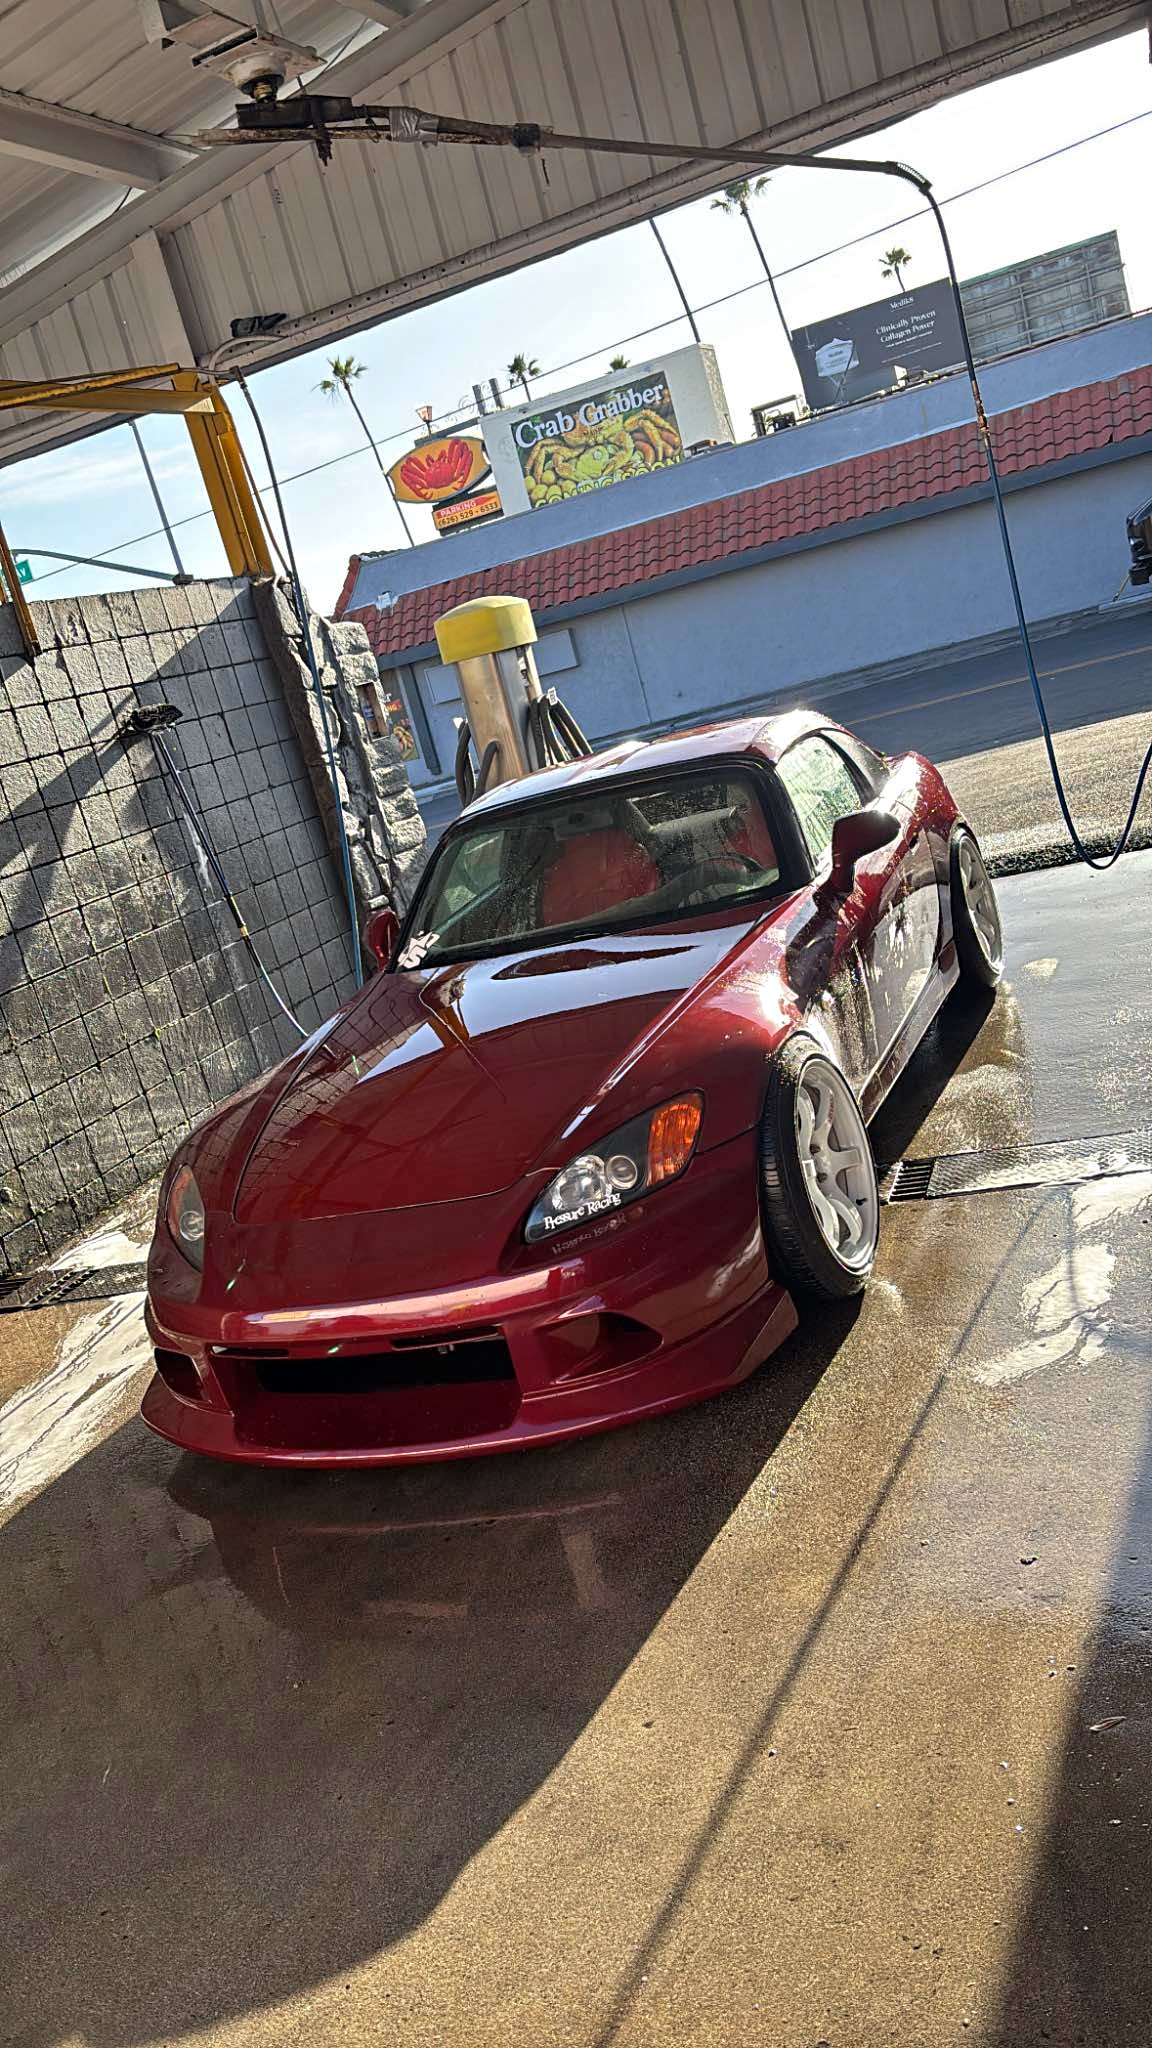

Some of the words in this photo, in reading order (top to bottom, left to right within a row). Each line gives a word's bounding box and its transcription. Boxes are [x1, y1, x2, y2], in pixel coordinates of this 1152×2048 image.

[876, 319, 909, 335] Clinically
[911, 310, 936, 323] Proven
[880, 328, 911, 342] Collagen
[912, 321, 935, 333] Power
[515, 411, 574, 448] Crab
[579, 384, 664, 427] Grabber
[439, 515, 459, 526] (626)
[460, 509, 474, 520] 529
[440, 501, 476, 517] PARKING
[544, 1207, 585, 1230] Pressure
[587, 1193, 621, 1214] Racing
